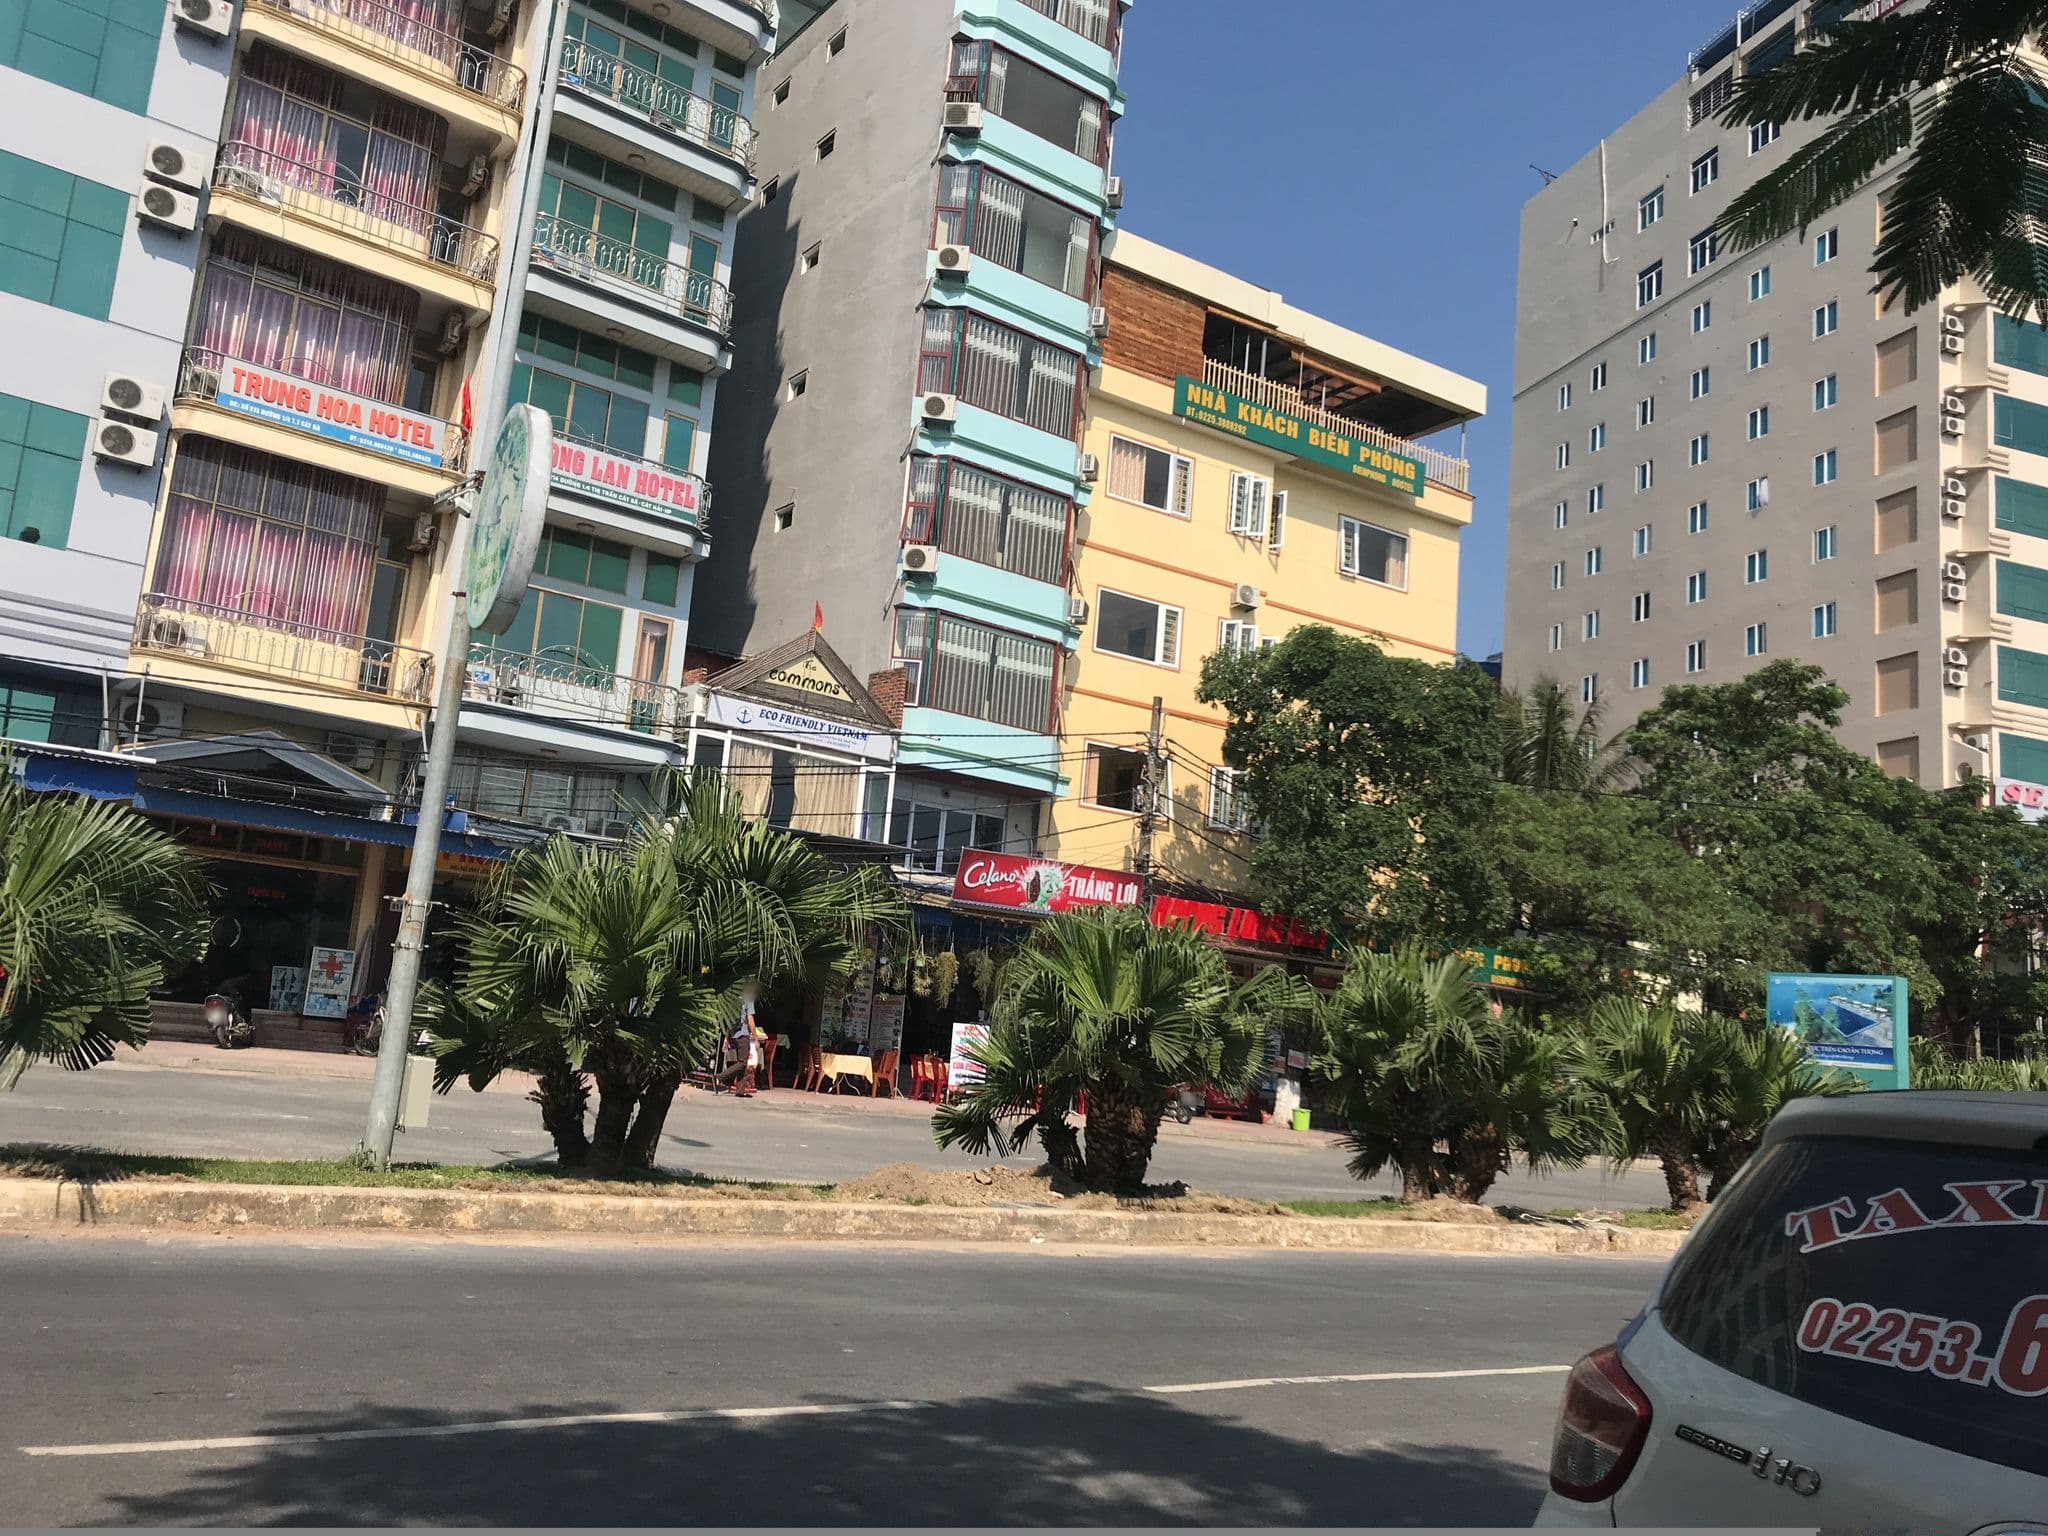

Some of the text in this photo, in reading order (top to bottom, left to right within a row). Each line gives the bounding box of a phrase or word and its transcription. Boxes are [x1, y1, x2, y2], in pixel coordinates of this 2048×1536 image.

[232, 367, 311, 413] TRUNG
[316, 393, 362, 428] HOA
[369, 409, 435, 449] HOTEL
[1187, 383, 1416, 480] NHÀ KHÁCH BIÊN PHÒNG
[591, 455, 630, 489] LAN
[634, 468, 695, 509] HOTEL
[759, 708, 779, 721] ECO
[779, 713, 826, 732] FRIENDLY
[827, 724, 868, 741] VIETNAM
[2002, 783, 2048, 811] SE
[963, 860, 1017, 889] Celano
[1678, 1426, 1746, 1461] GRAND
